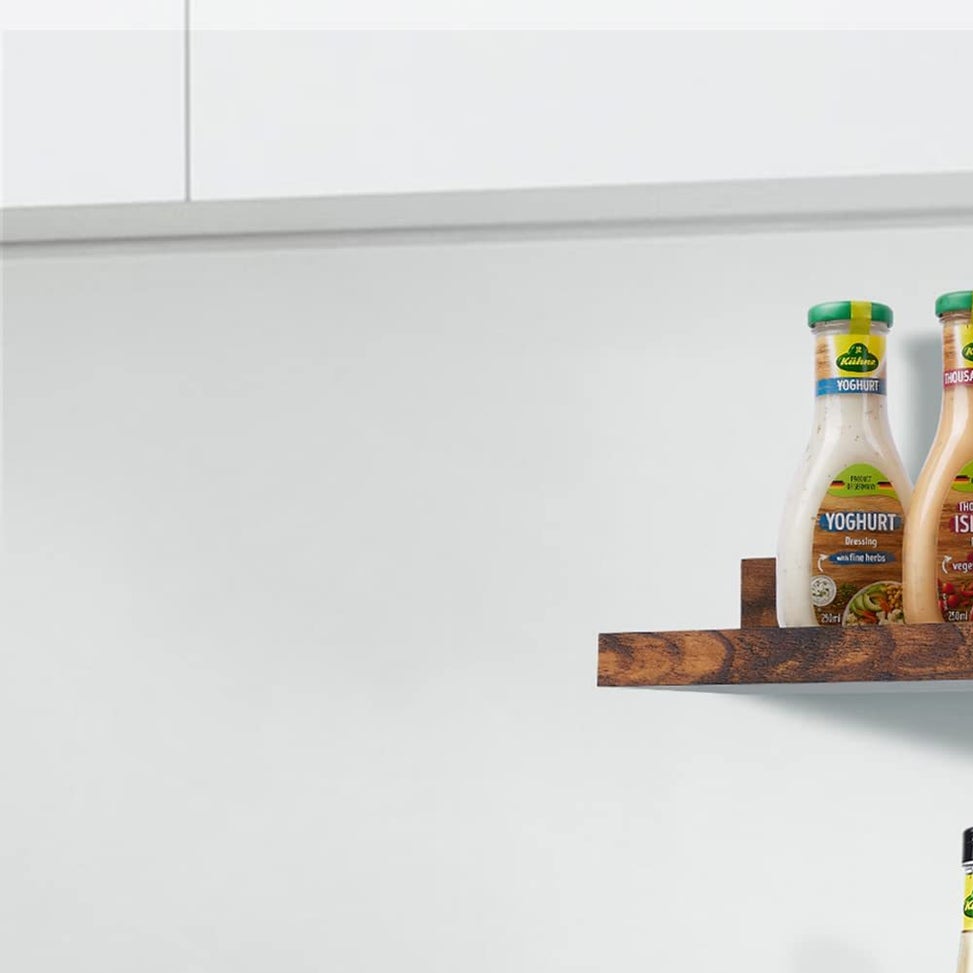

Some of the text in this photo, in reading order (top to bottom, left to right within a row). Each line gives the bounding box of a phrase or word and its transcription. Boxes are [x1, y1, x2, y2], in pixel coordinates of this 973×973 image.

[840, 356, 876, 366] Kühne
[837, 379, 879, 391] YOGHURT
[825, 512, 897, 531] YOGHURT
[844, 536, 878, 548] Dressing
[849, 551, 865, 562] fine
[865, 551, 886, 562] herbs
[947, 611, 968, 621] 250ml
